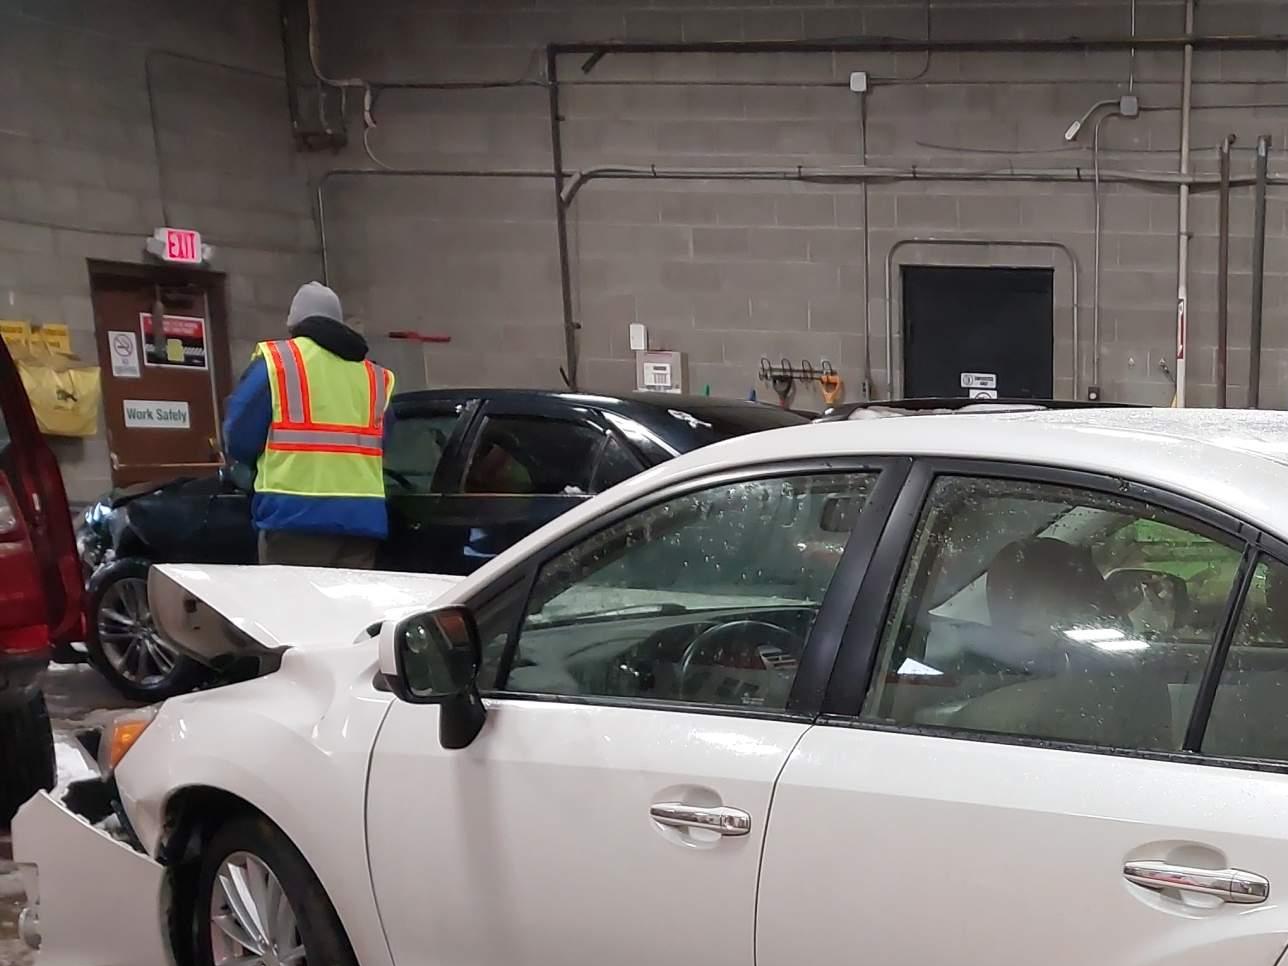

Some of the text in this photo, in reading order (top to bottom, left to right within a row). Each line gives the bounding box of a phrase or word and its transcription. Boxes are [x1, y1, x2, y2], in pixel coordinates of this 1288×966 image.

[167, 230, 196, 259] EXIT
[127, 408, 186, 423] Work Safely
